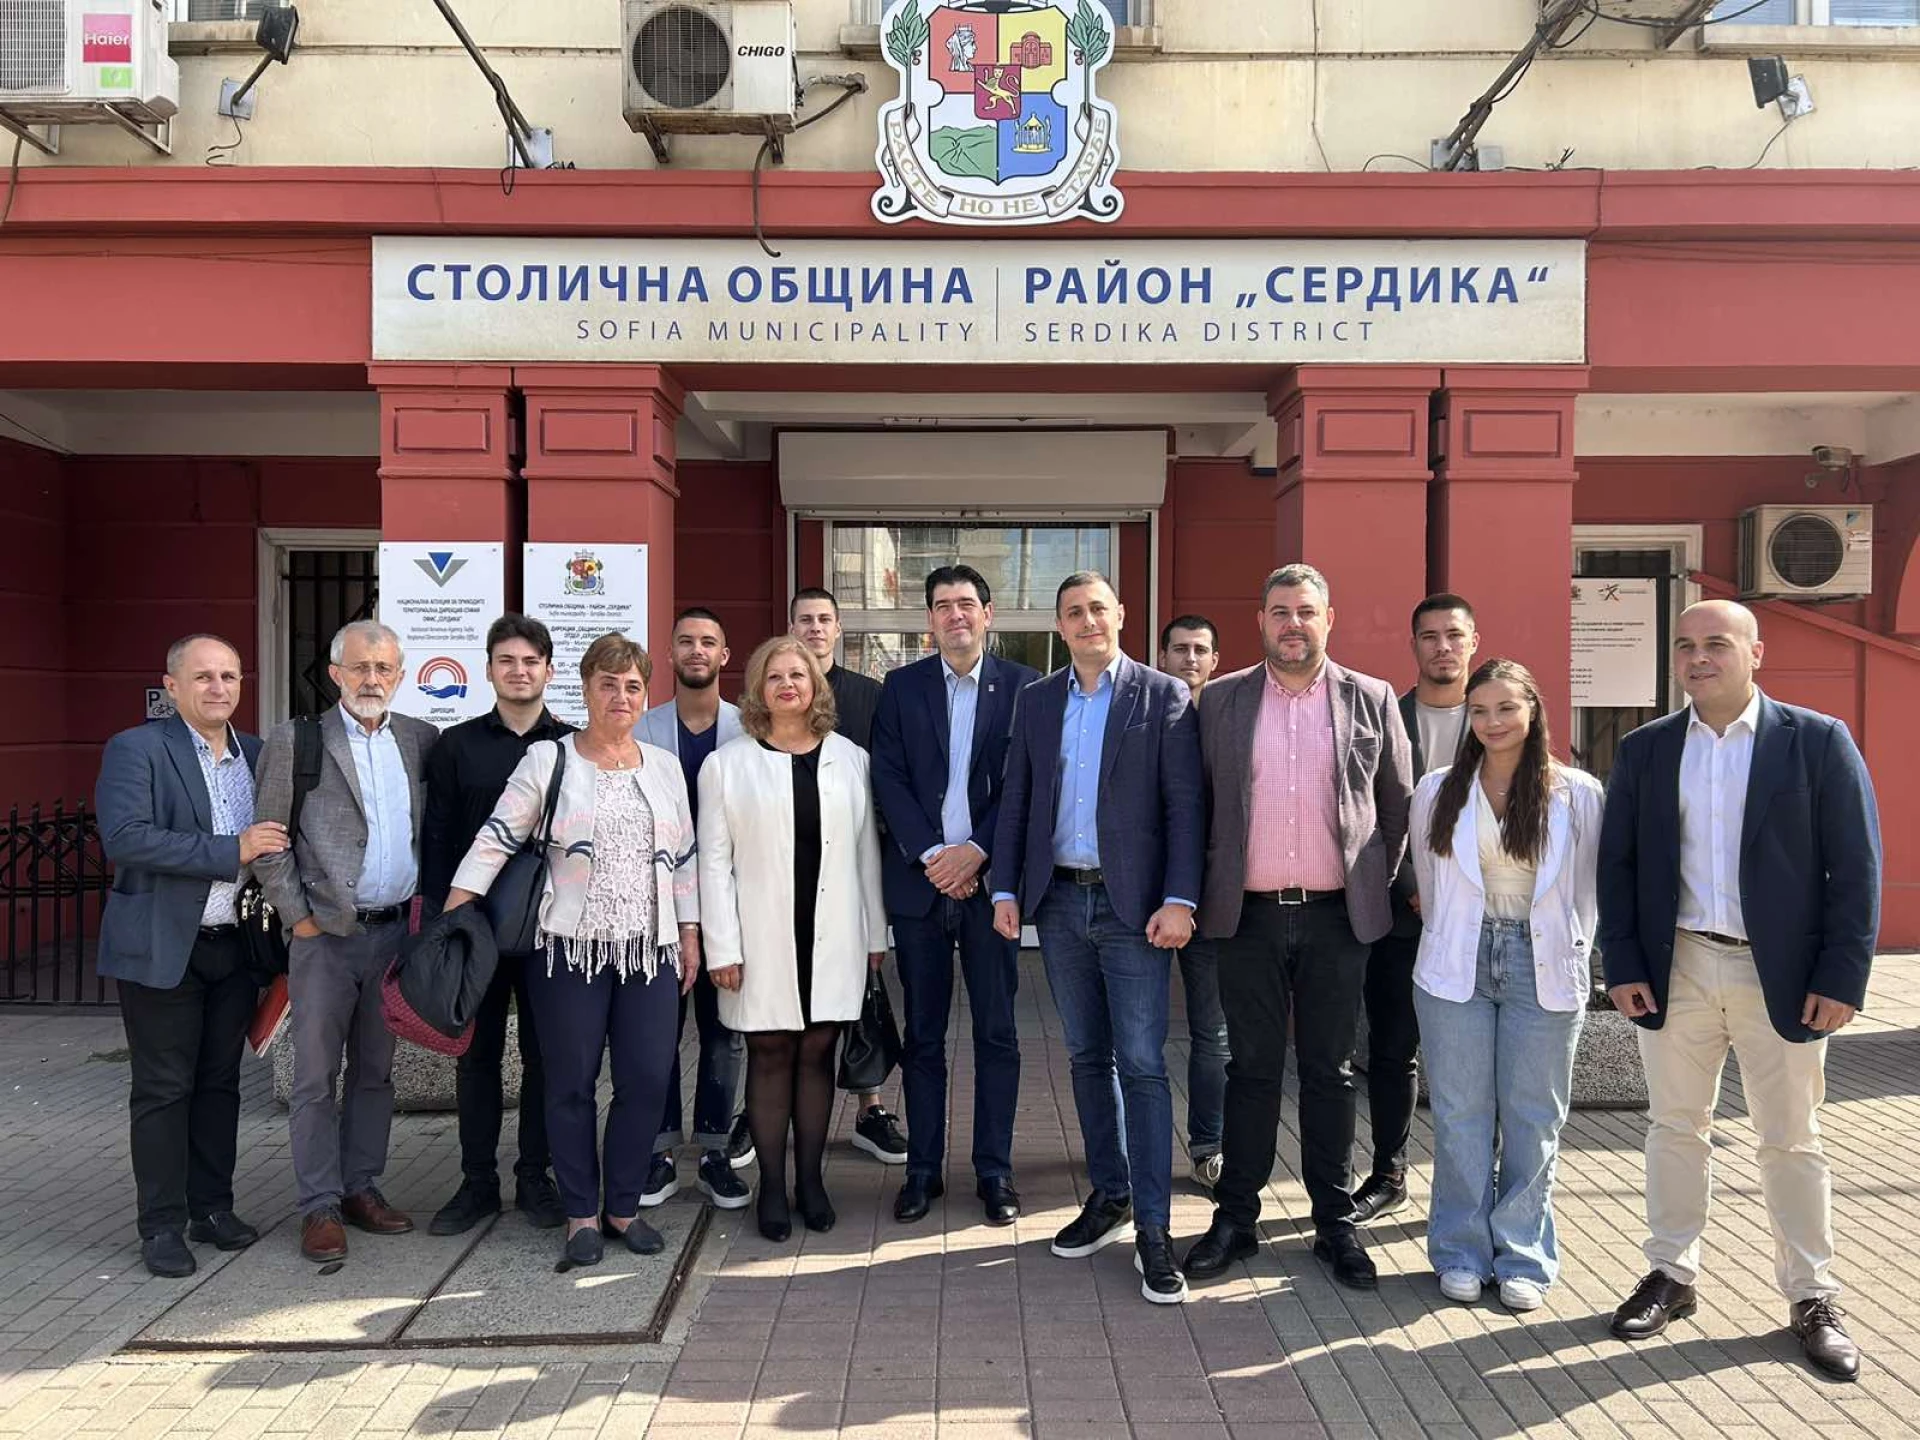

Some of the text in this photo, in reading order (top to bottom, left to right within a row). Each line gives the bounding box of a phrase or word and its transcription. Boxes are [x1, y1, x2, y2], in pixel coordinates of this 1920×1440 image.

[84, 32, 130, 46] Haier
[737, 46, 785, 57] CHIGO
[889, 121, 938, 208] РАСТЕ
[959, 198, 993, 214] НО
[1003, 198, 1040, 215] НЕ
[408, 264, 973, 312] СТОЛИЧНА ОБЩИНА
[1025, 260, 1211, 304] РАЙОН
[577, 320, 973, 342] SOFIA MUNICIPALITY
[1025, 321, 1373, 343] SERDIKA DISTRICT
